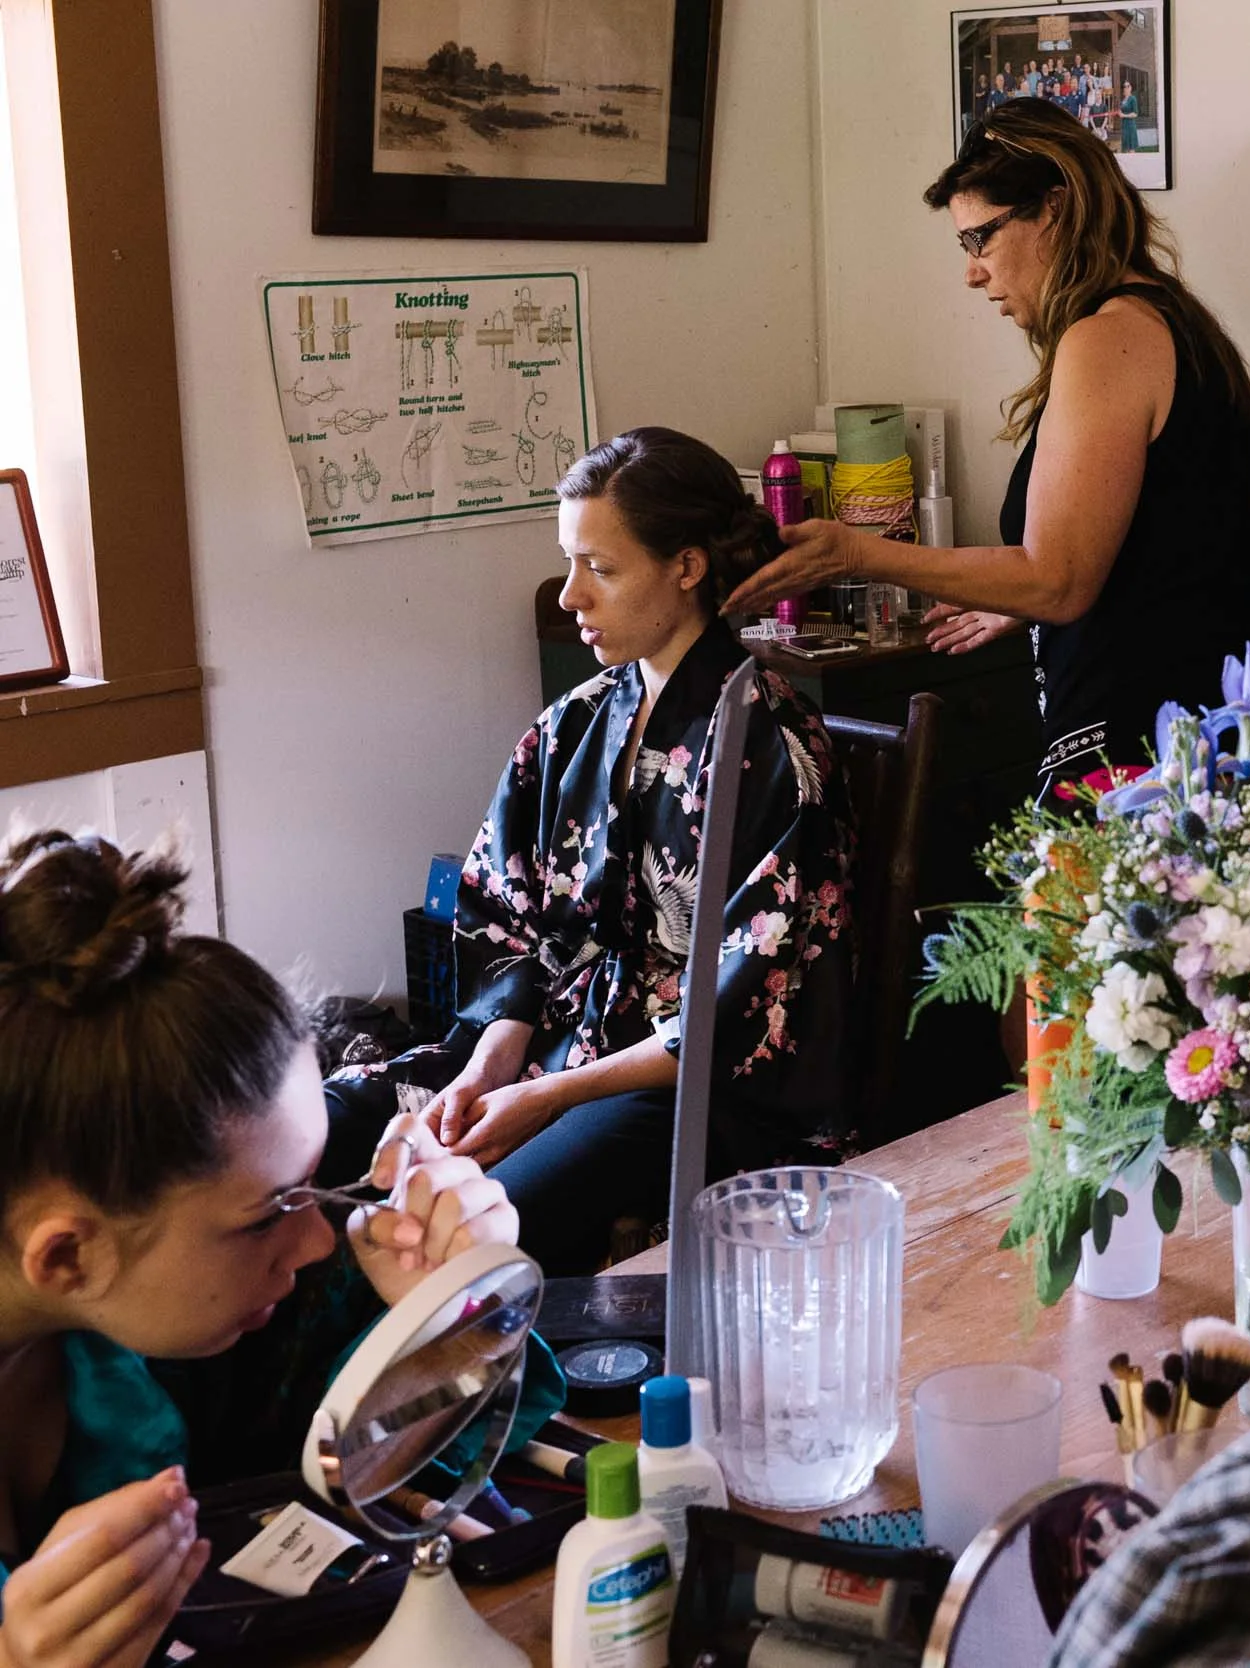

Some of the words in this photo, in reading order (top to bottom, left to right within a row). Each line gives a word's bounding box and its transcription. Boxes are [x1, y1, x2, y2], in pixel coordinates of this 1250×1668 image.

[395, 291, 469, 310] Knotting
[301, 353, 325, 362] Clove
[329, 351, 351, 361] hitch
[508, 357, 561, 371] Highwayman's
[522, 367, 541, 378] hitch
[399, 395, 425, 406] Round
[426, 395, 445, 404] turn
[448, 392, 463, 401] and
[400, 407, 415, 417] two
[418, 405, 433, 415] half
[437, 403, 466, 413] hitches
[307, 432, 327, 441] knot
[392, 493, 413, 502] Sheet
[417, 490, 434, 500] bend
[529, 487, 557, 498] Bowlin
[457, 495, 504, 508] Sheepshank
[341, 512, 361, 522] rope
[0, 557, 26, 571] orest
[591, 1558, 667, 1598] Cetaphil
